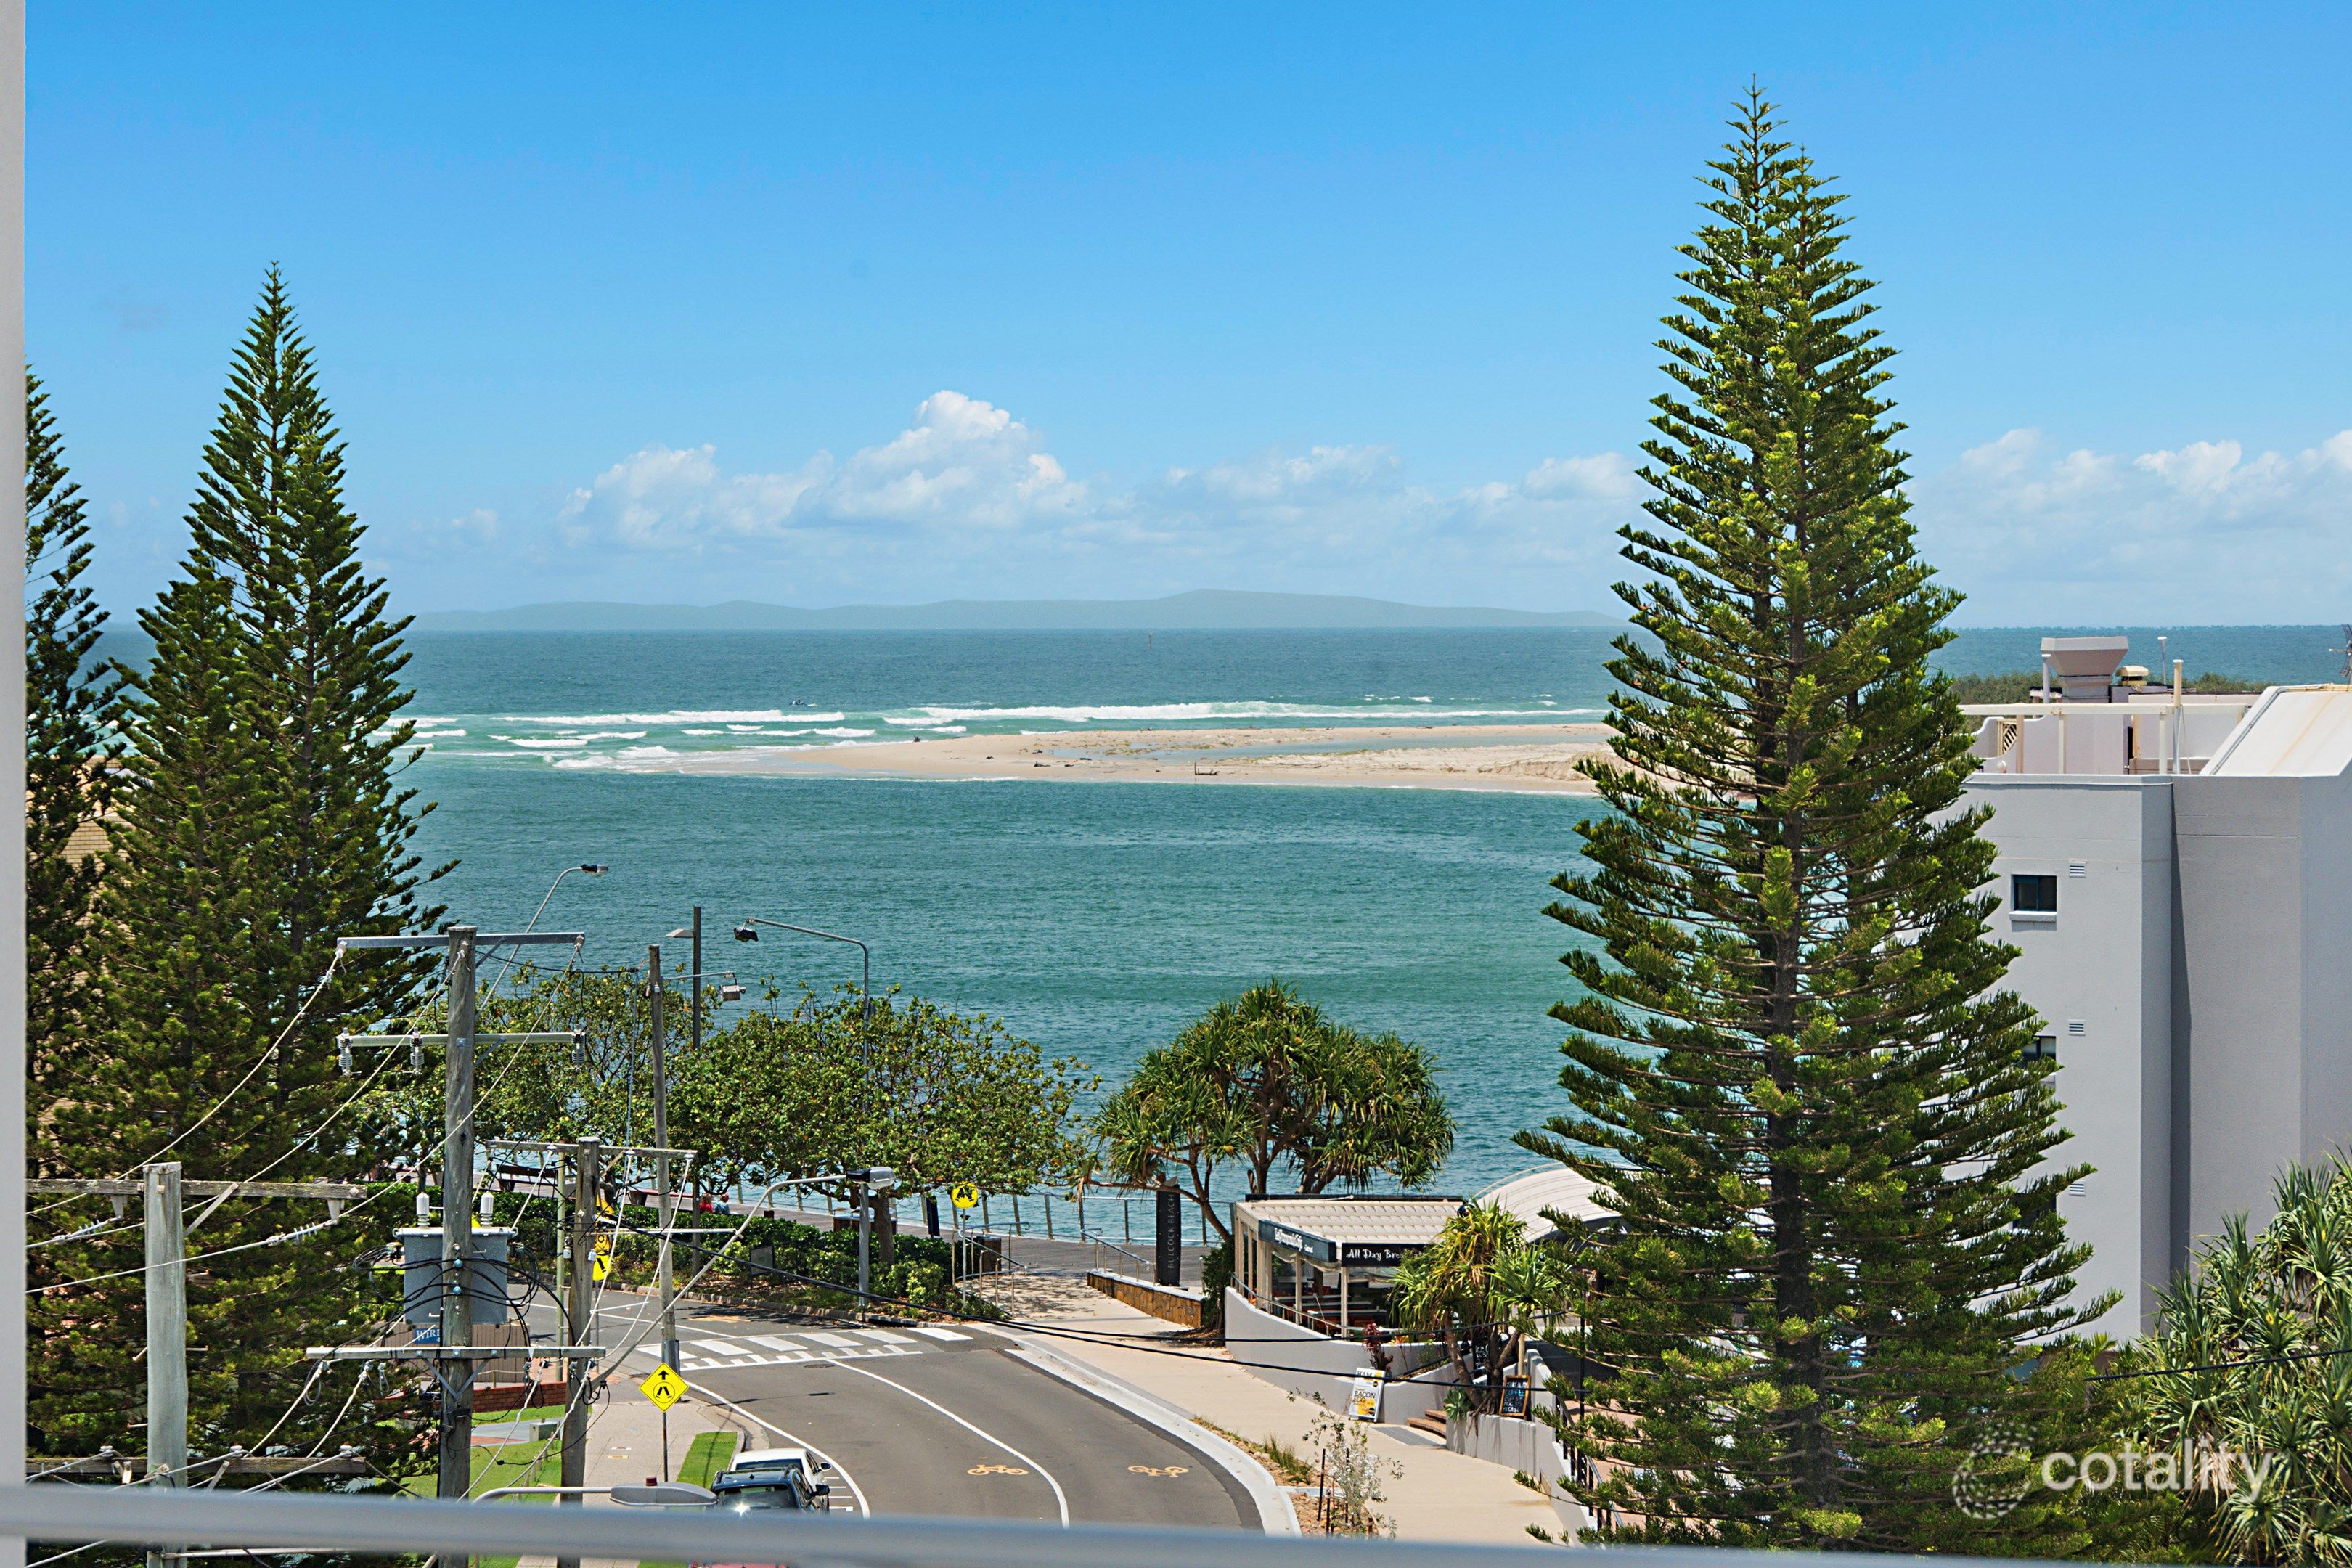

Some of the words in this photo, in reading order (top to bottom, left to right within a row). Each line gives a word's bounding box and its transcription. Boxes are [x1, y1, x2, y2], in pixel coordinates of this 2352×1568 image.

[1346, 1248, 1360, 1259] All
[1363, 1248, 1381, 1261] Day
[1354, 1390, 1376, 1399] BACON
